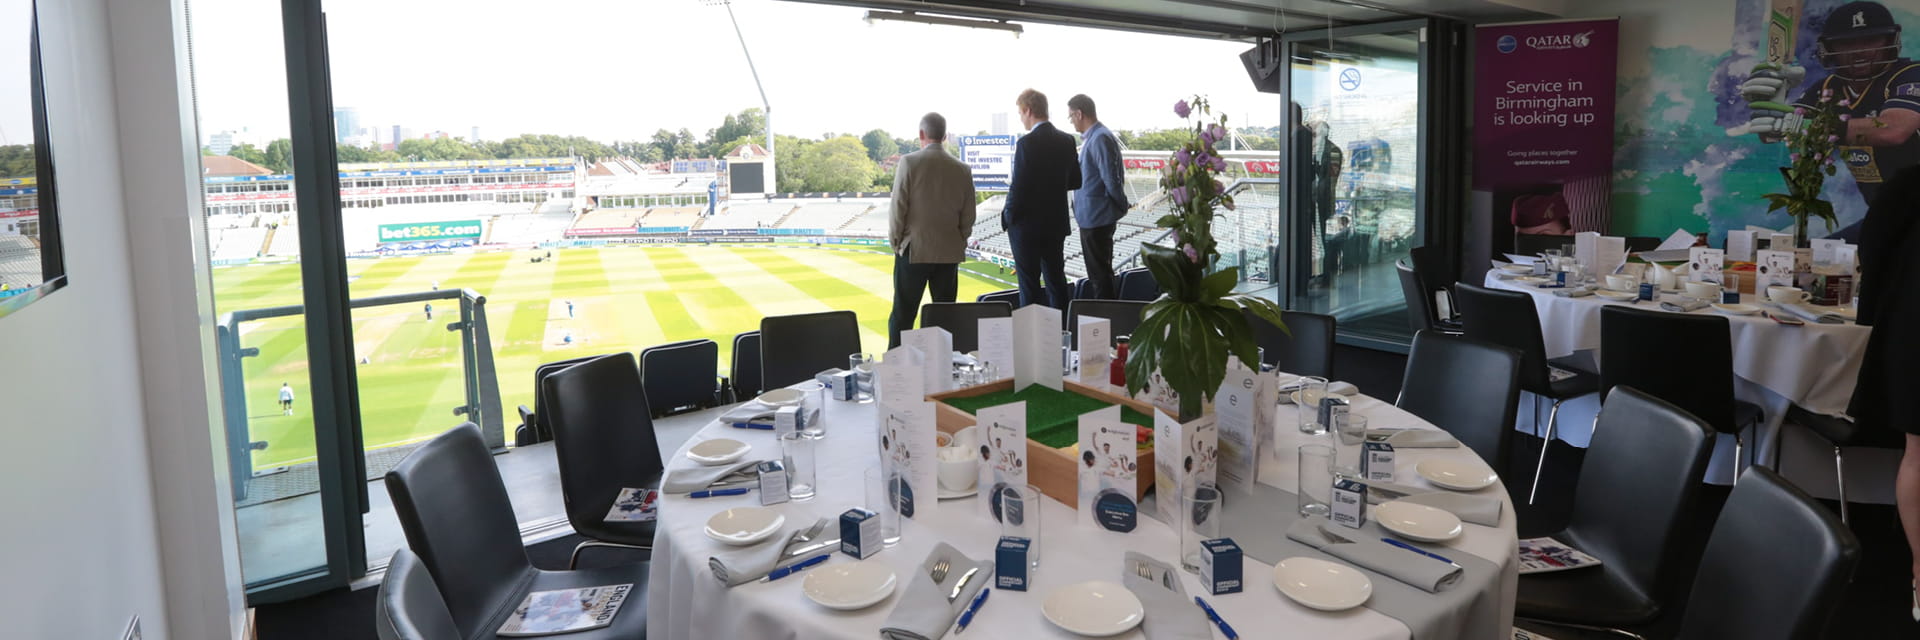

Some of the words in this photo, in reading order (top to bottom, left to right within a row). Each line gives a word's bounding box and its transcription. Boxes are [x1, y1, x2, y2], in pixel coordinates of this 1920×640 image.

[1526, 35, 1571, 48] QATAR
[1506, 80, 1562, 94] Service
[1568, 78, 1583, 91] in
[1496, 94, 1593, 111] Birmingham
[1494, 113, 1505, 125] is
[1510, 111, 1567, 127] looking
[1573, 112, 1594, 126] up
[1507, 150, 1527, 158] Going
[1549, 149, 1578, 157] together
[381, 225, 480, 239] bet365.com
[597, 585, 629, 620] ENGLAND
